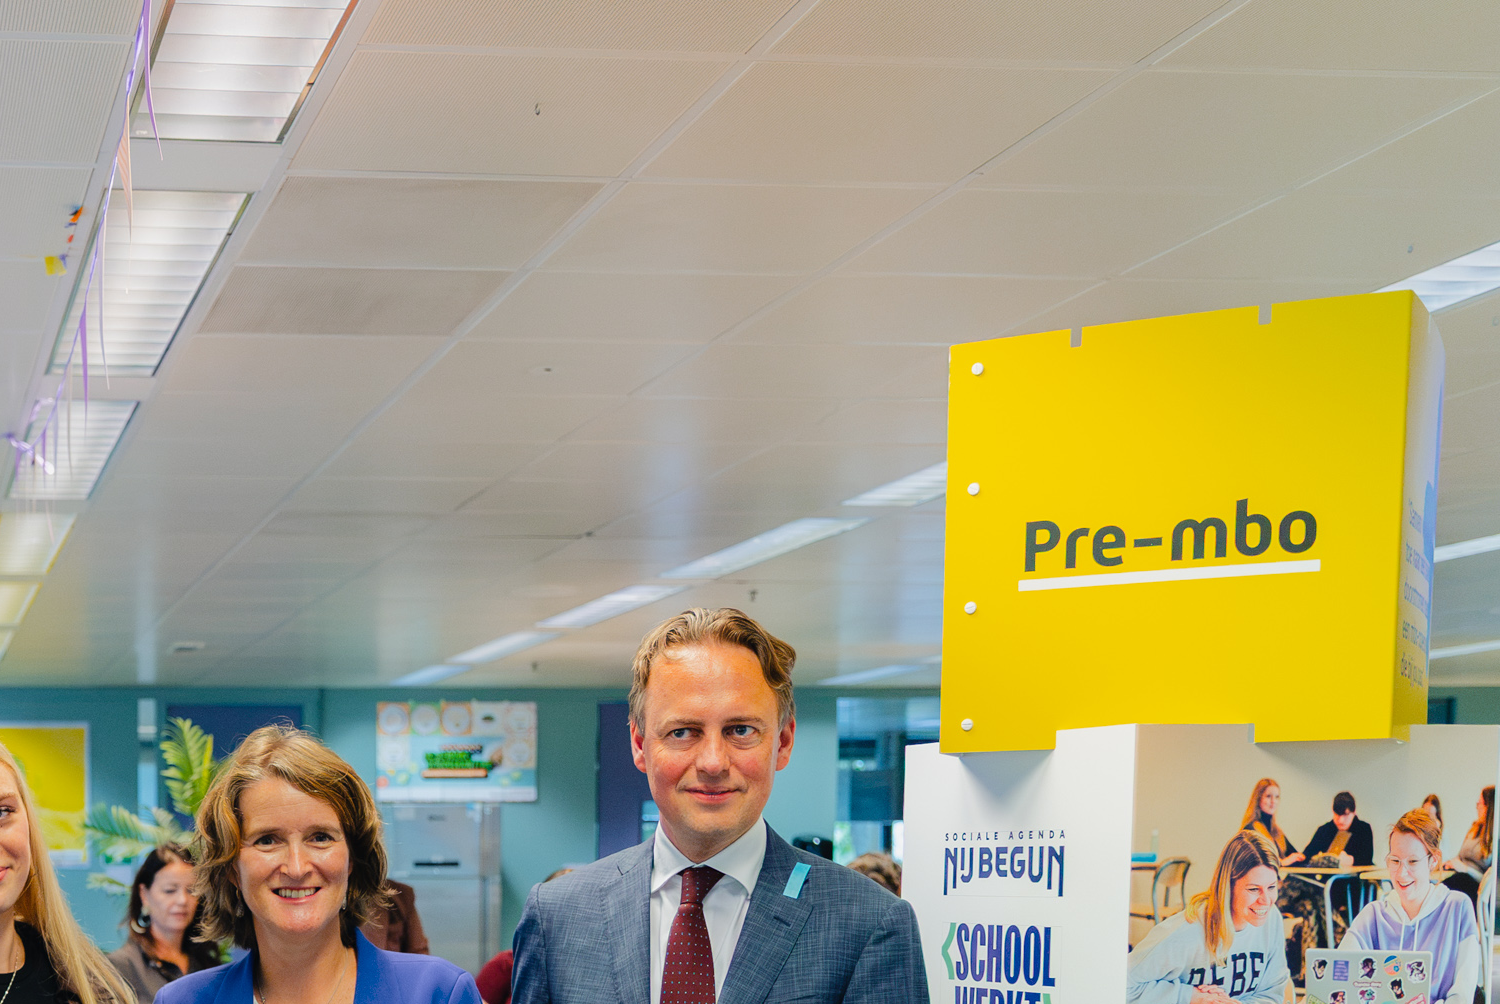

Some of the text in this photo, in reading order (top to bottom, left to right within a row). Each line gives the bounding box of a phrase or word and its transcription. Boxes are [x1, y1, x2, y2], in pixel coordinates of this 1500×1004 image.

[1024, 498, 1318, 573] Pre-mbo
[945, 829, 1066, 842] SOCIALE AGENDA
[955, 922, 1056, 987] SCHOOL
